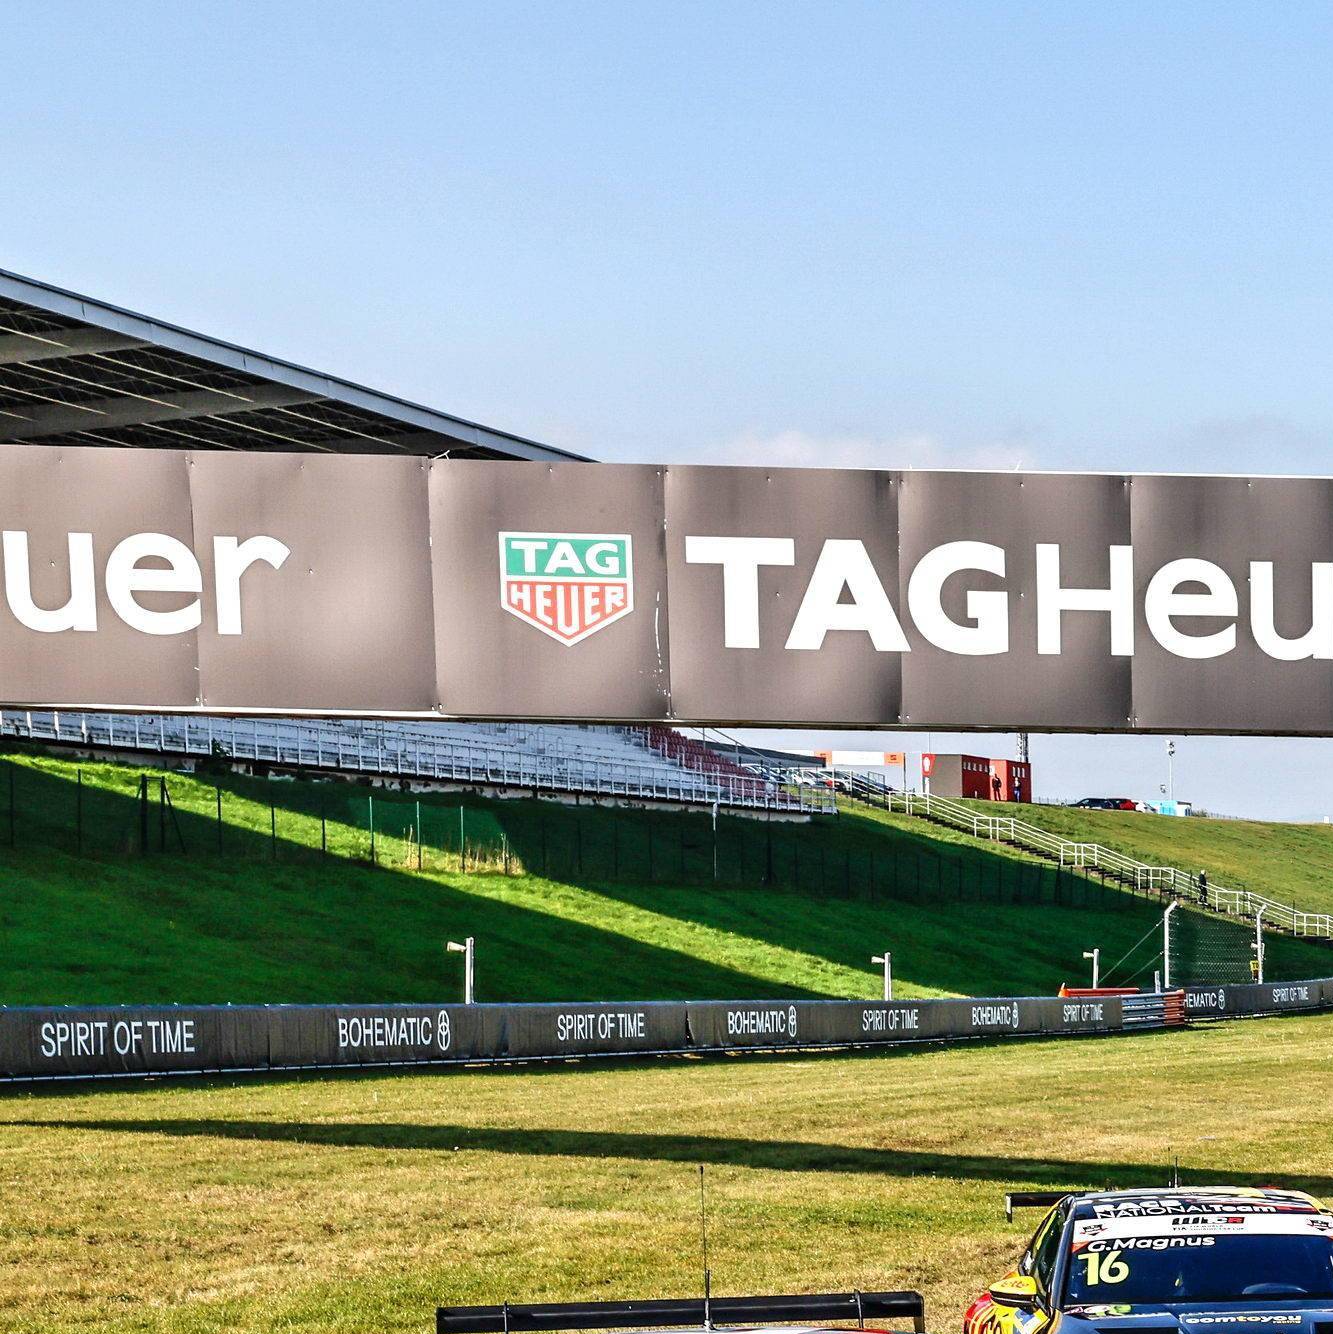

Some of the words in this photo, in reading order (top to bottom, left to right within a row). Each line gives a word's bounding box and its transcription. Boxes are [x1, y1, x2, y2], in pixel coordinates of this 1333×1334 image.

[510, 539, 622, 577] TAG
[3, 530, 291, 635] uer
[507, 582, 629, 637] HEUER
[1063, 1004, 1080, 1023] SPIRIT
[1081, 1004, 1090, 1022] OF
[1090, 1003, 1103, 1021] TIME
[1184, 990, 1217, 1009] HEMATIC
[557, 1014, 596, 1041] SPIRIT
[599, 1013, 616, 1040] OF
[618, 1012, 645, 1039] TIME
[727, 1010, 786, 1035] BOHEMATIC
[863, 1010, 888, 1032] SPIRIT
[888, 1010, 900, 1031] OF
[900, 1009, 919, 1029] TIME
[972, 1006, 1011, 1026] BOHEMATIC
[41, 1021, 108, 1057] SPIRIT
[114, 1021, 143, 1055] OF
[147, 1020, 195, 1053] TIME
[338, 1017, 432, 1047] BOHEMATIC
[1088, 1236, 1216, 1251] G.Magnus
[1077, 1250, 1130, 1286] 16
